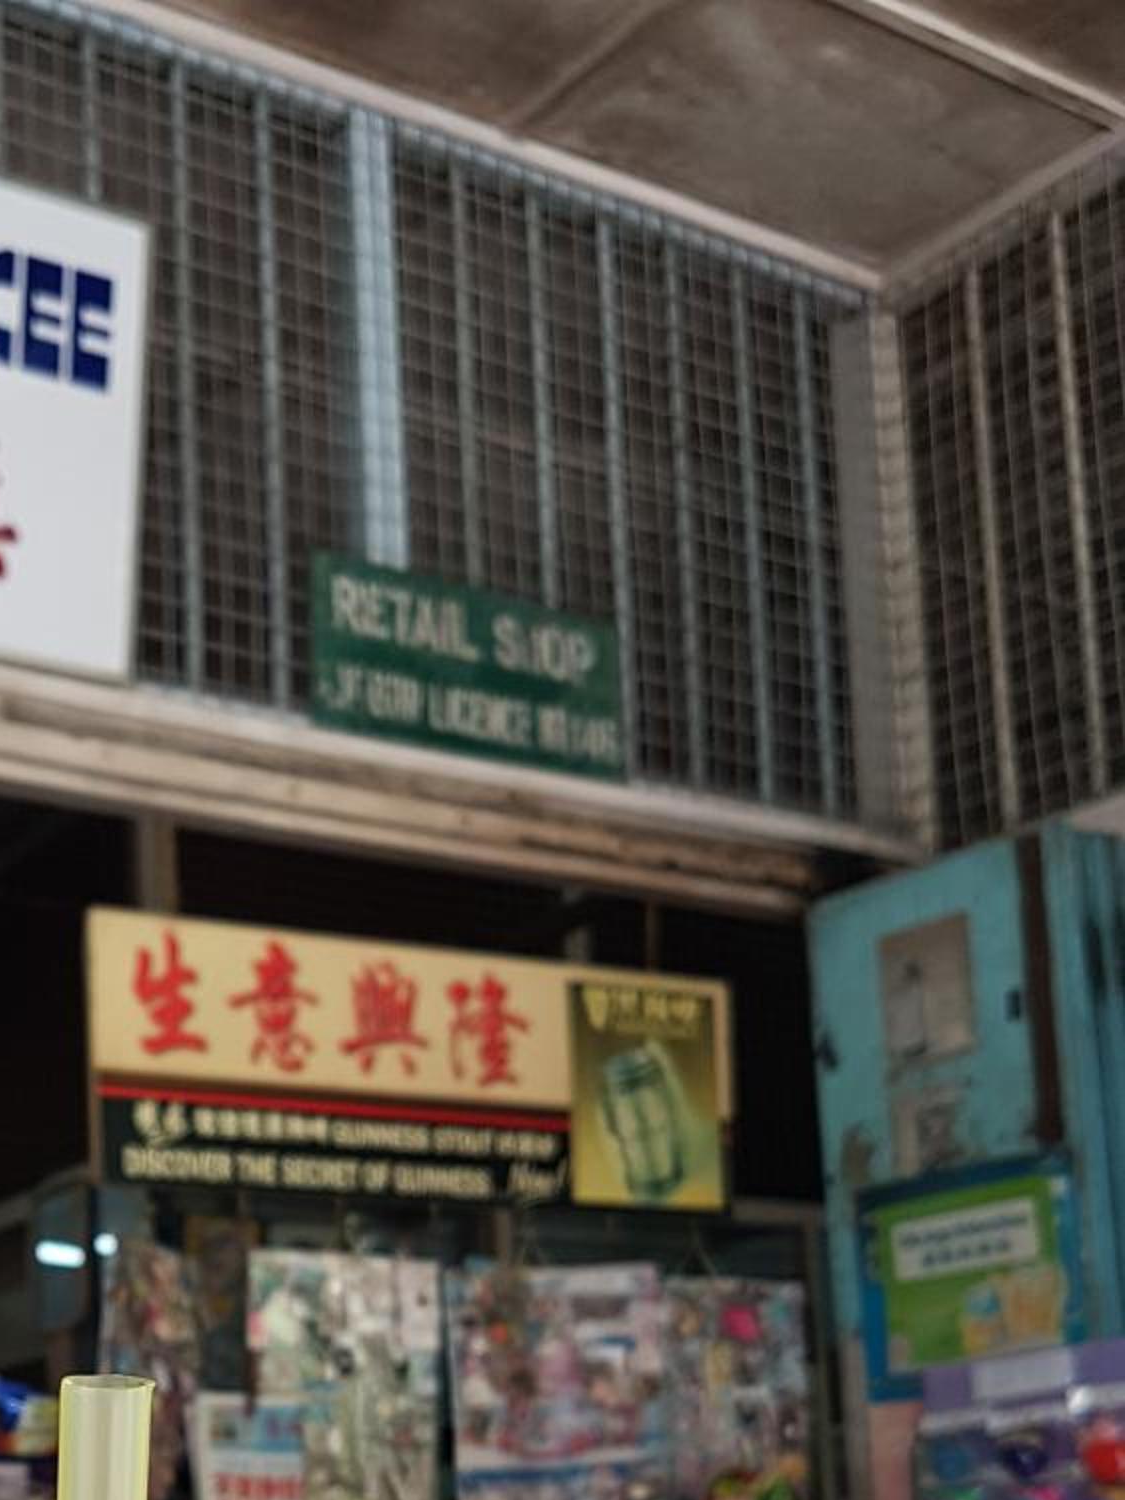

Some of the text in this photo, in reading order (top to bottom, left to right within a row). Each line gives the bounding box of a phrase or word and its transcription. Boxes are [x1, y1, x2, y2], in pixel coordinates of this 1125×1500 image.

[330, 574, 481, 662] RETAIL
[132, 928, 531, 1088] 生意興隆
